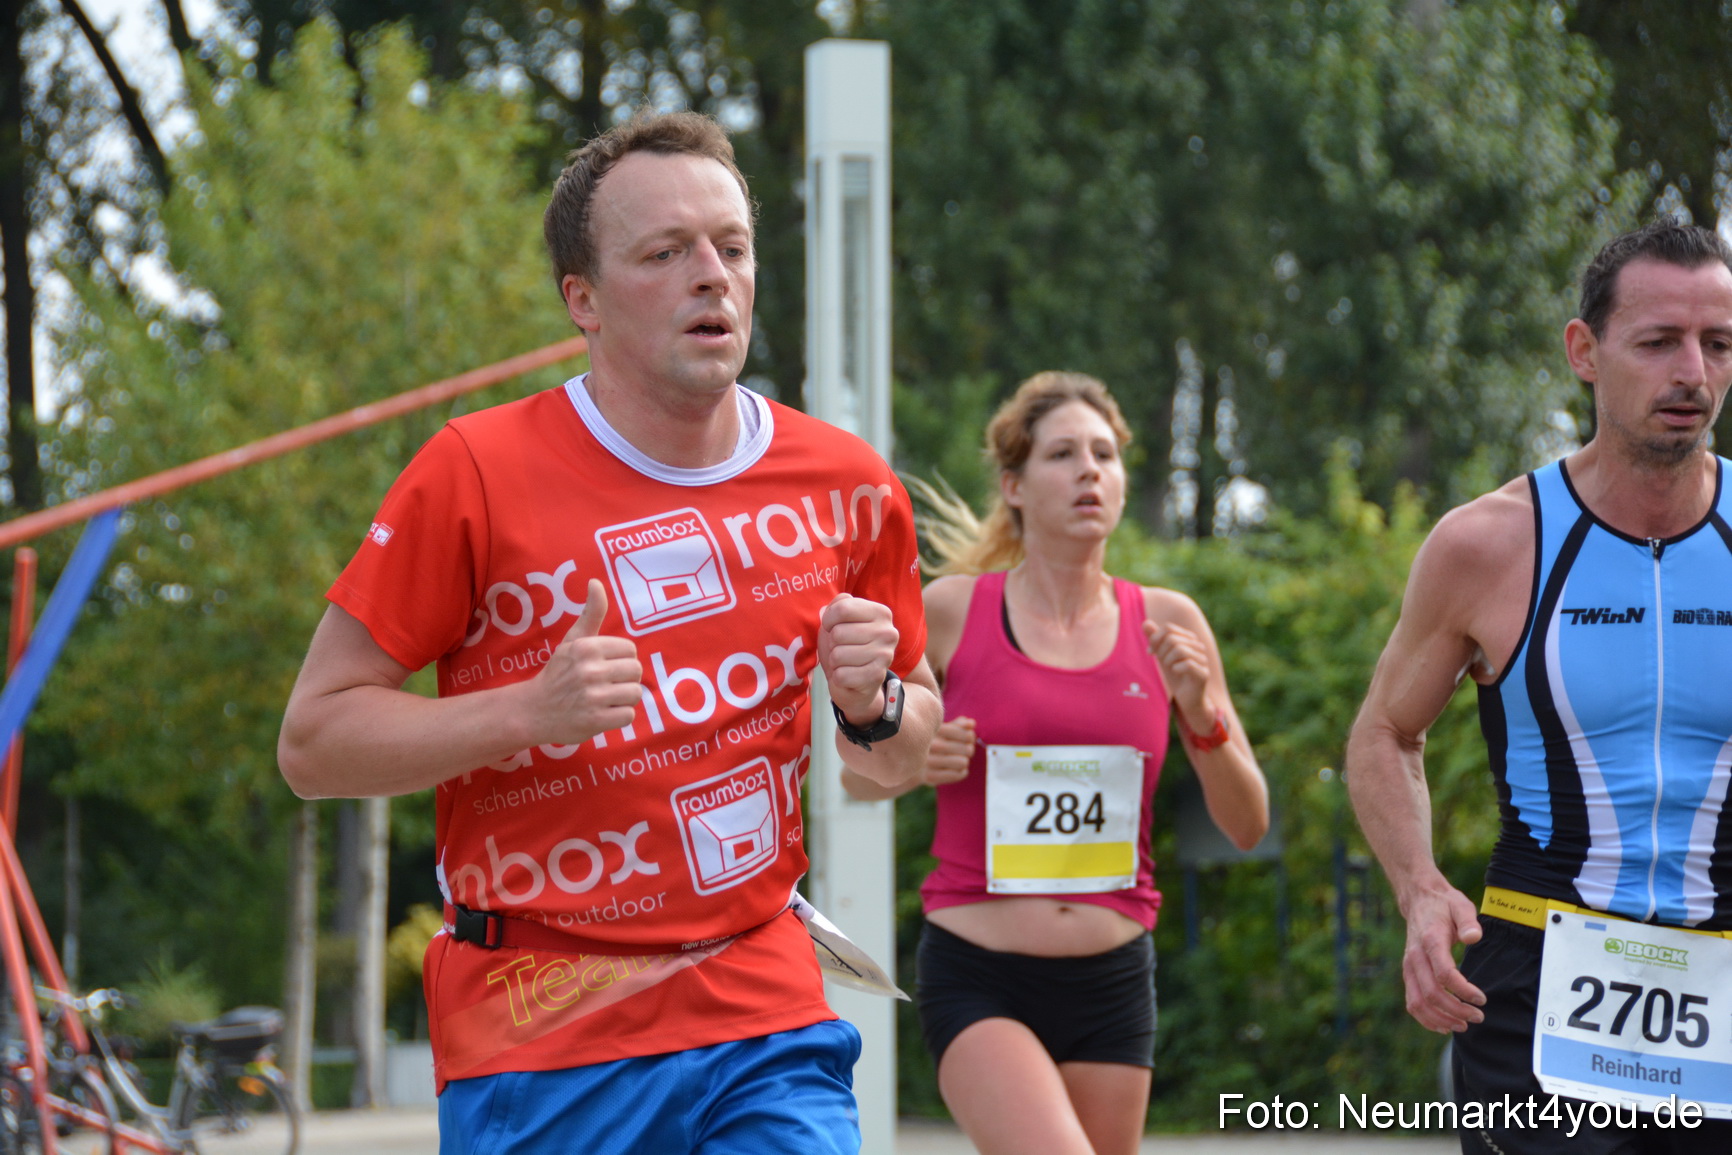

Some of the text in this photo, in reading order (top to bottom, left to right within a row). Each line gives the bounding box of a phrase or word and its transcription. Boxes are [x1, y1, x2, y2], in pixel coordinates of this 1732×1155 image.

[606, 517, 701, 556] raumbox
[751, 562, 839, 602] schenken
[473, 772, 583, 815] schenken
[604, 739, 709, 780] wohnen
[726, 700, 800, 744] outdoor
[680, 769, 767, 816] raumbox
[1025, 791, 1106, 835] 284
[557, 891, 667, 928] outdoor
[1625, 940, 1689, 966] BOCK
[1566, 975, 1710, 1049] 2705
[1591, 1053, 1682, 1085] Reinhard
